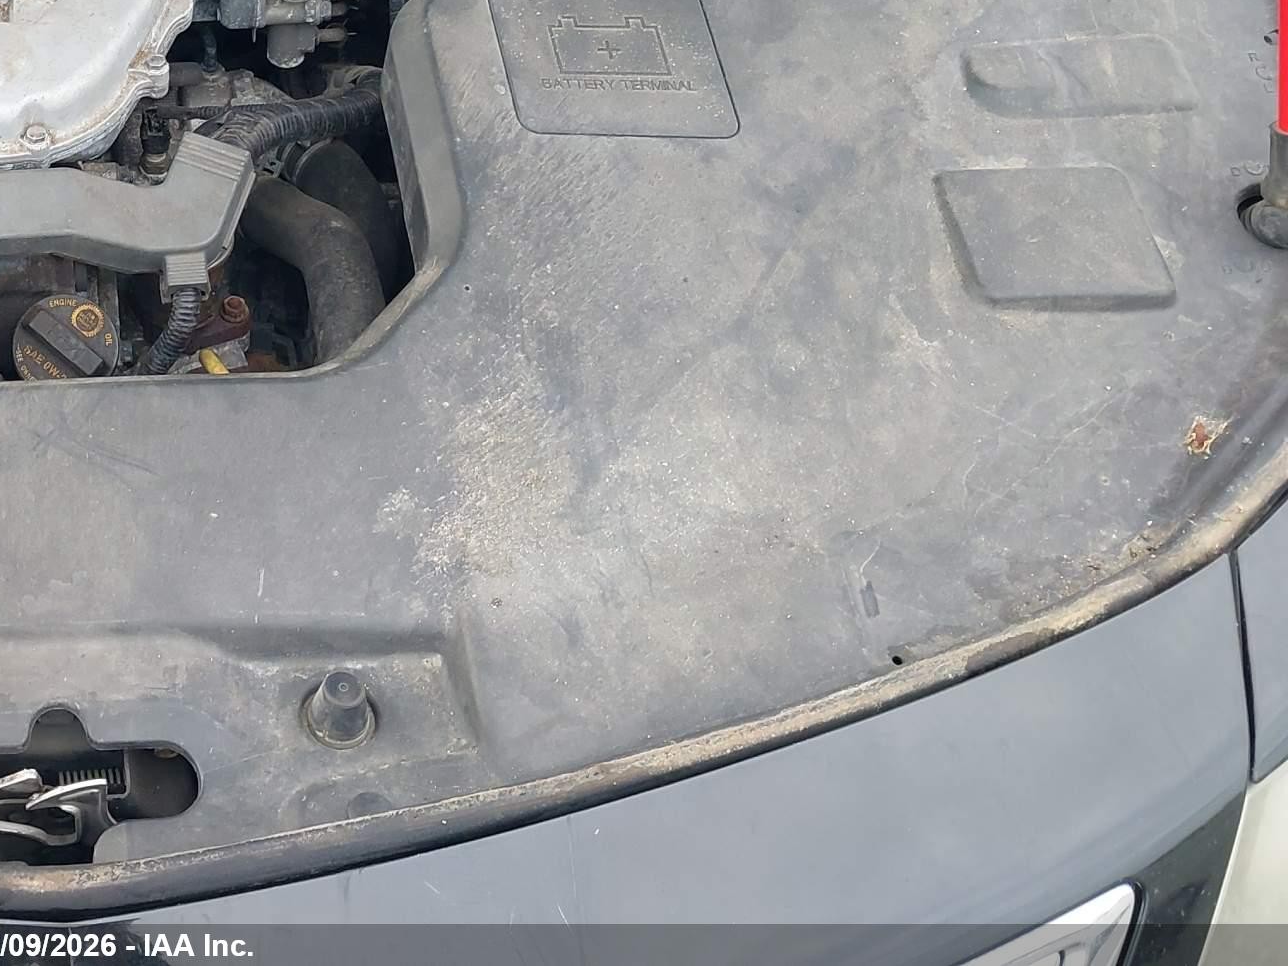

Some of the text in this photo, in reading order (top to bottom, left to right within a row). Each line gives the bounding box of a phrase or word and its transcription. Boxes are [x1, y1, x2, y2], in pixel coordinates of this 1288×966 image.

[540, 78, 697, 92] BATTERY TERMINAL
[49, 298, 113, 346] ENGINE OIL
